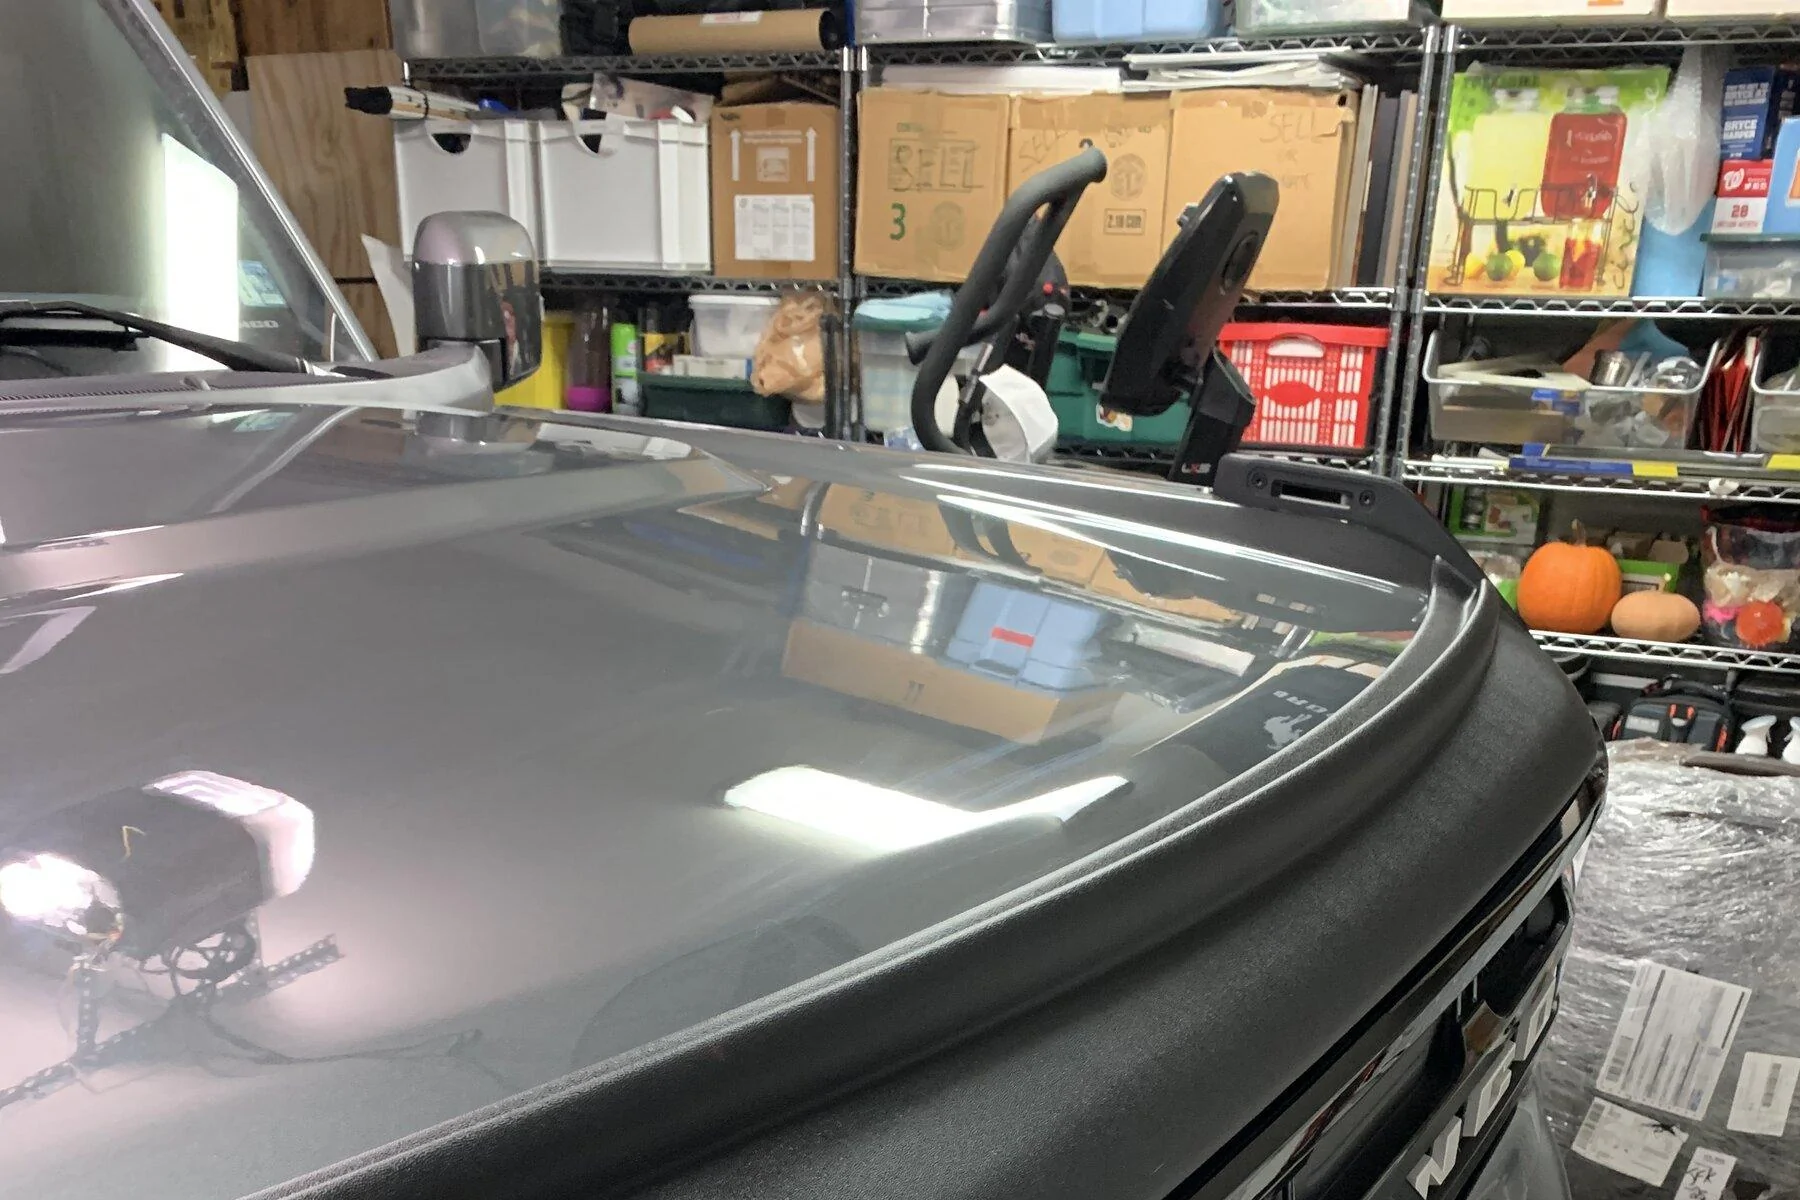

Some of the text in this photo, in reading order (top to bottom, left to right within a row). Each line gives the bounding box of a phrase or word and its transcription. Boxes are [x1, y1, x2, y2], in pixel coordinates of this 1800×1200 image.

[1258, 111, 1323, 144] SELL
[1724, 119, 1758, 131] BRYCE
[893, 144, 985, 192] SELL
[889, 202, 907, 241] 3
